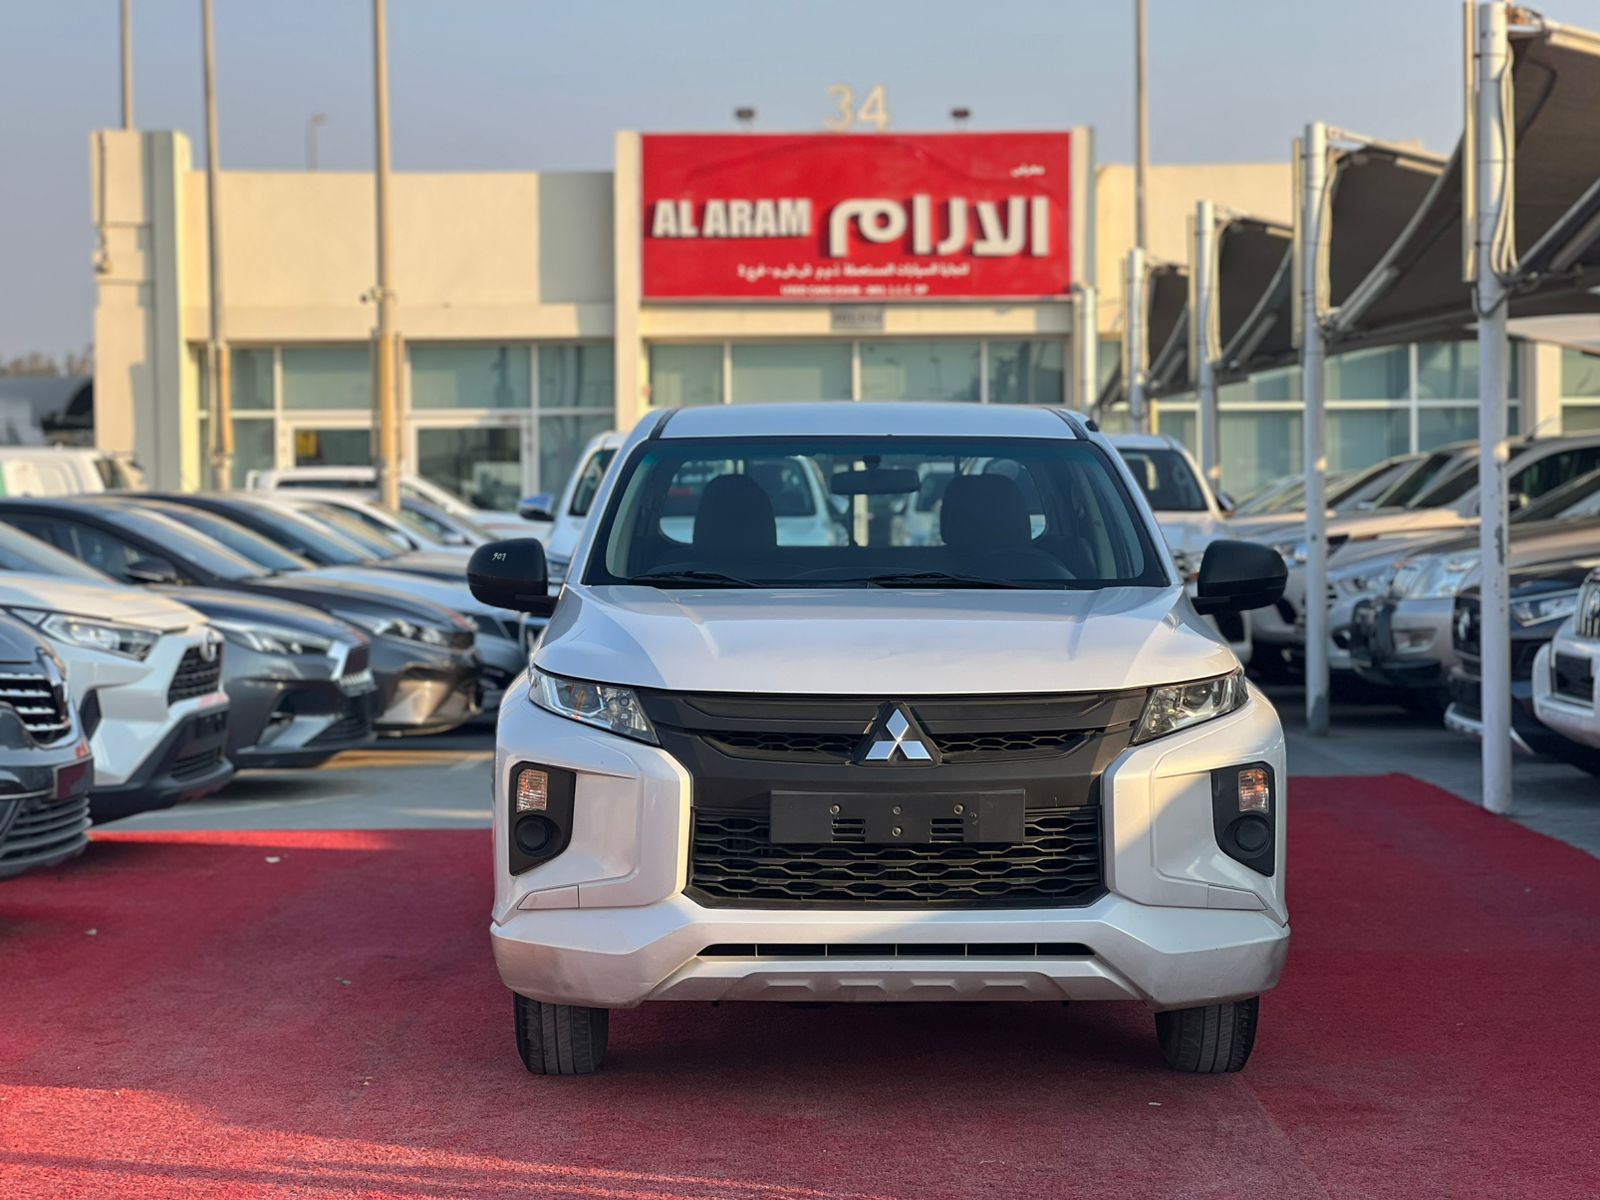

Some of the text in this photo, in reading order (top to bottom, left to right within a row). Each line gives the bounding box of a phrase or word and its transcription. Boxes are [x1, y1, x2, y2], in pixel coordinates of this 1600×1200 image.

[825, 83, 891, 130] 34
[652, 199, 810, 237] AL ARAM
